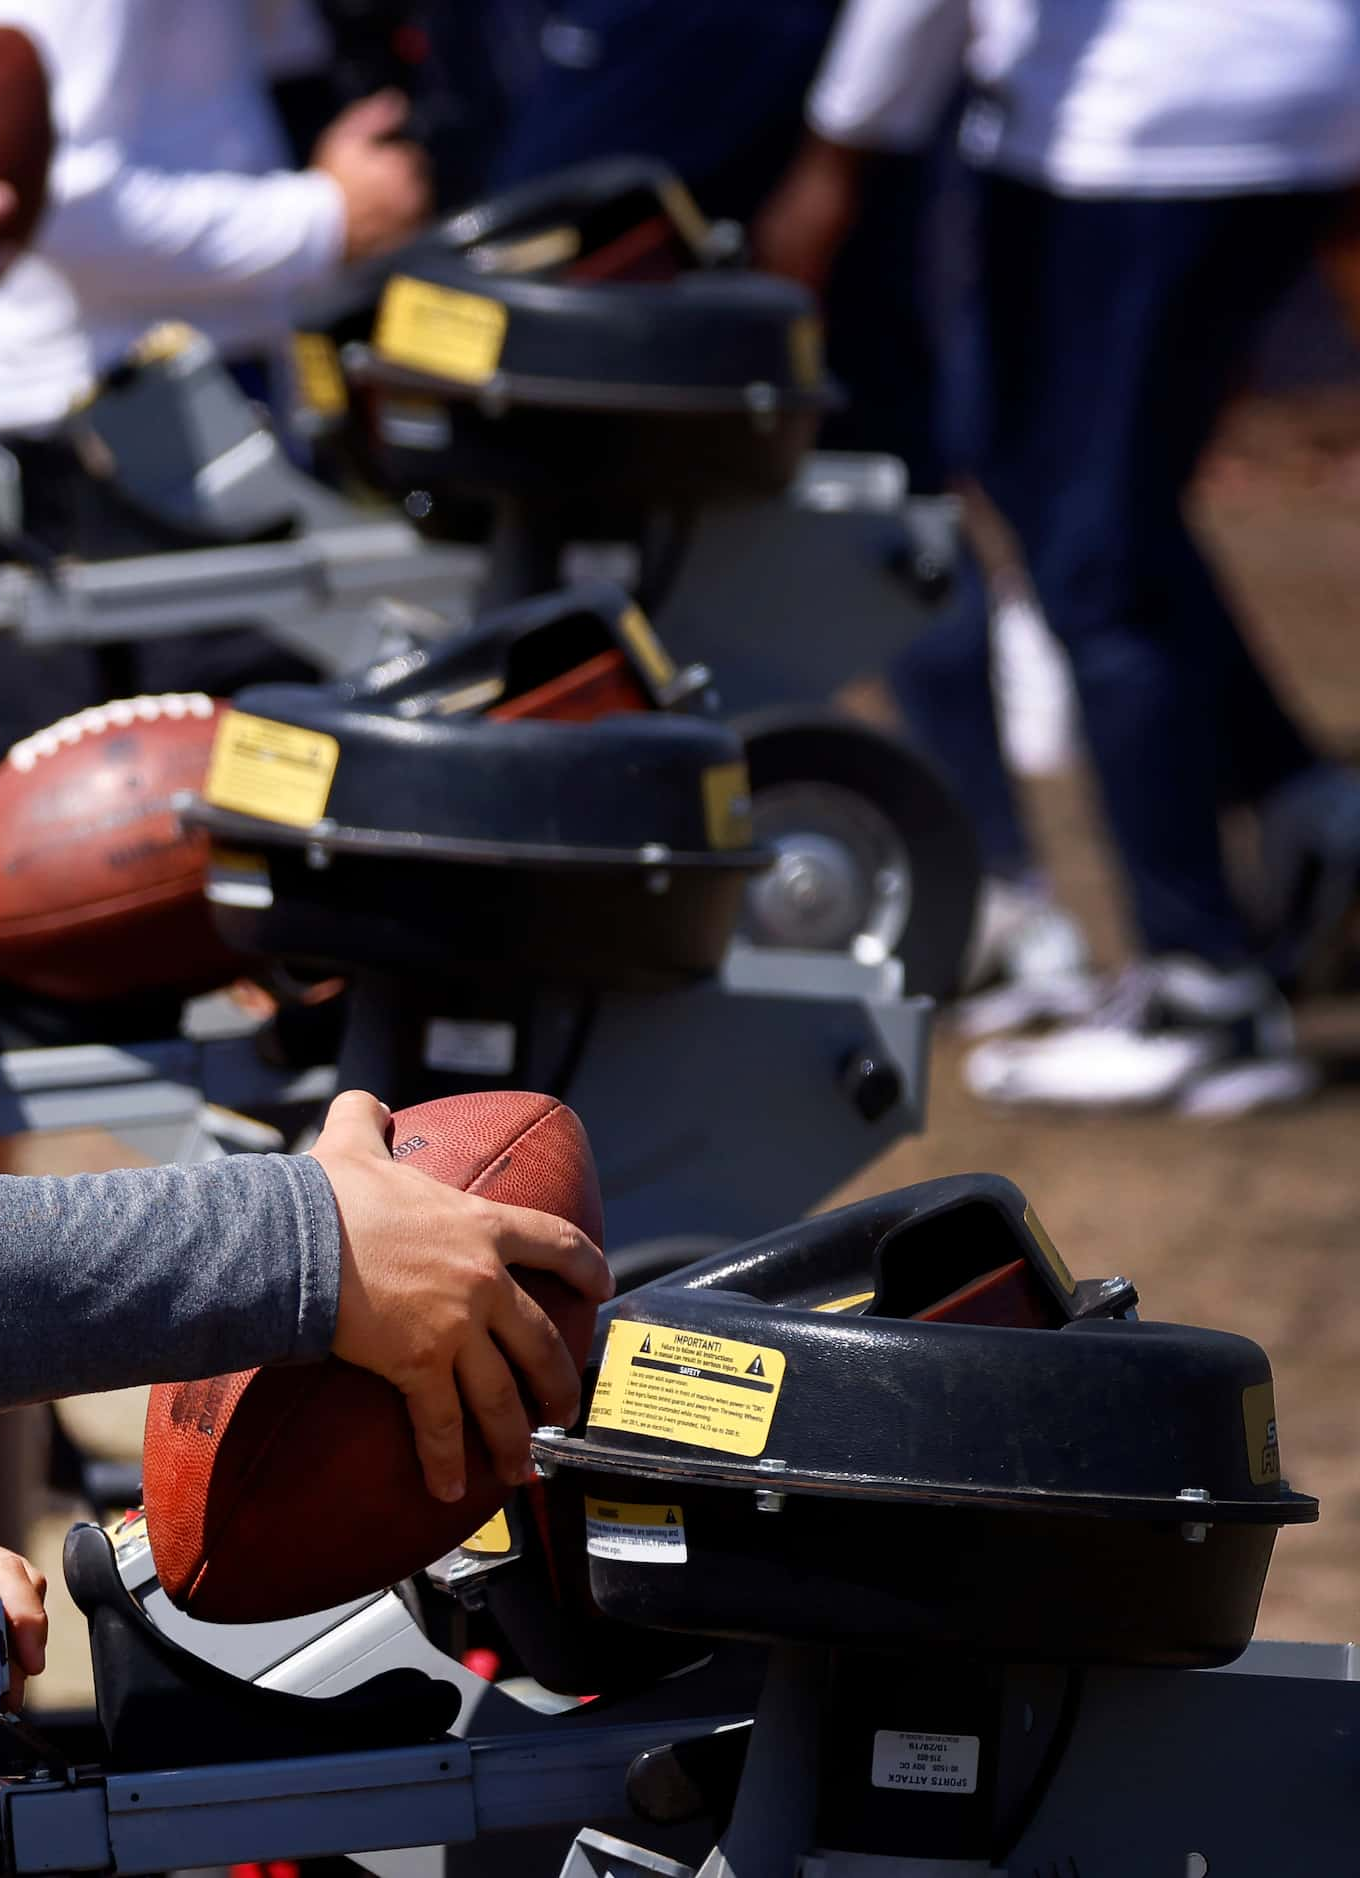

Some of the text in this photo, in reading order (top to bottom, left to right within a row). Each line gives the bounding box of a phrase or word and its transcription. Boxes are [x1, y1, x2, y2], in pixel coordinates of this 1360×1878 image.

[674, 1334, 722, 1352] IMPORTANT!
[680, 1366, 701, 1376] SAFETY
[888, 1774, 968, 1787] SPORTS ATTACK
